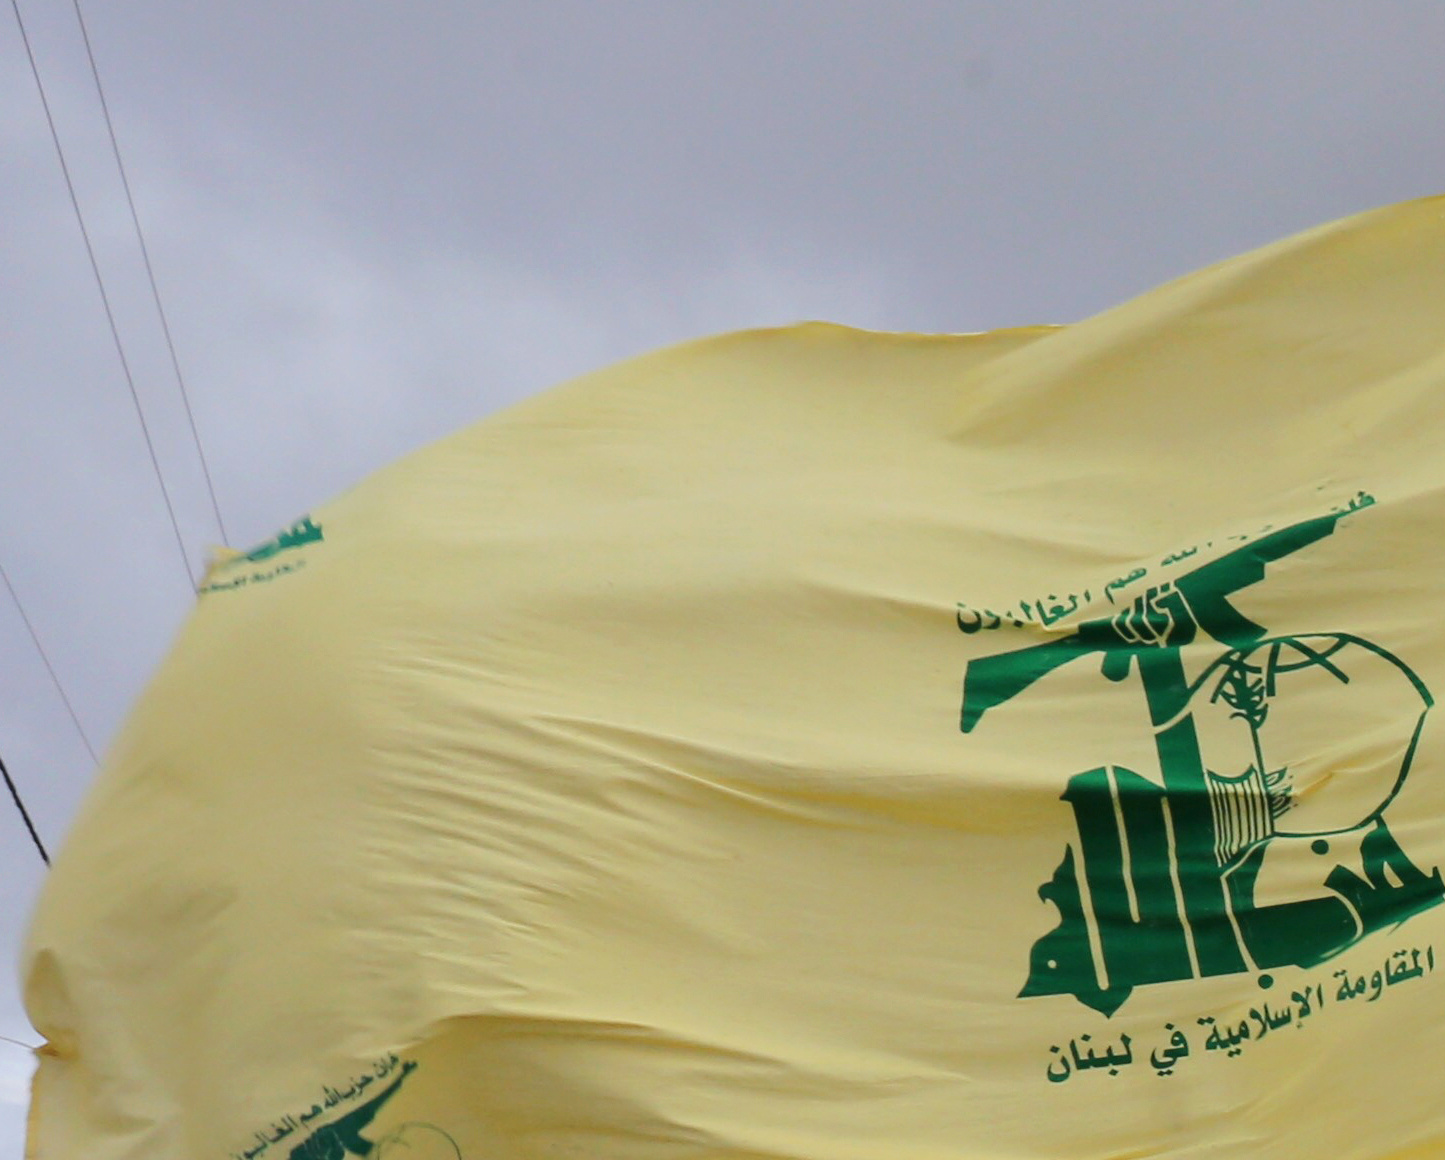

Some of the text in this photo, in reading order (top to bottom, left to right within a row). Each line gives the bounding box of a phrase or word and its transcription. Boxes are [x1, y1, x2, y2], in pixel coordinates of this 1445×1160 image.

[1333, 944, 1435, 1002] المقاومة
[1046, 1032, 1133, 1084] لبنان
[1149, 1022, 1190, 1077] في
